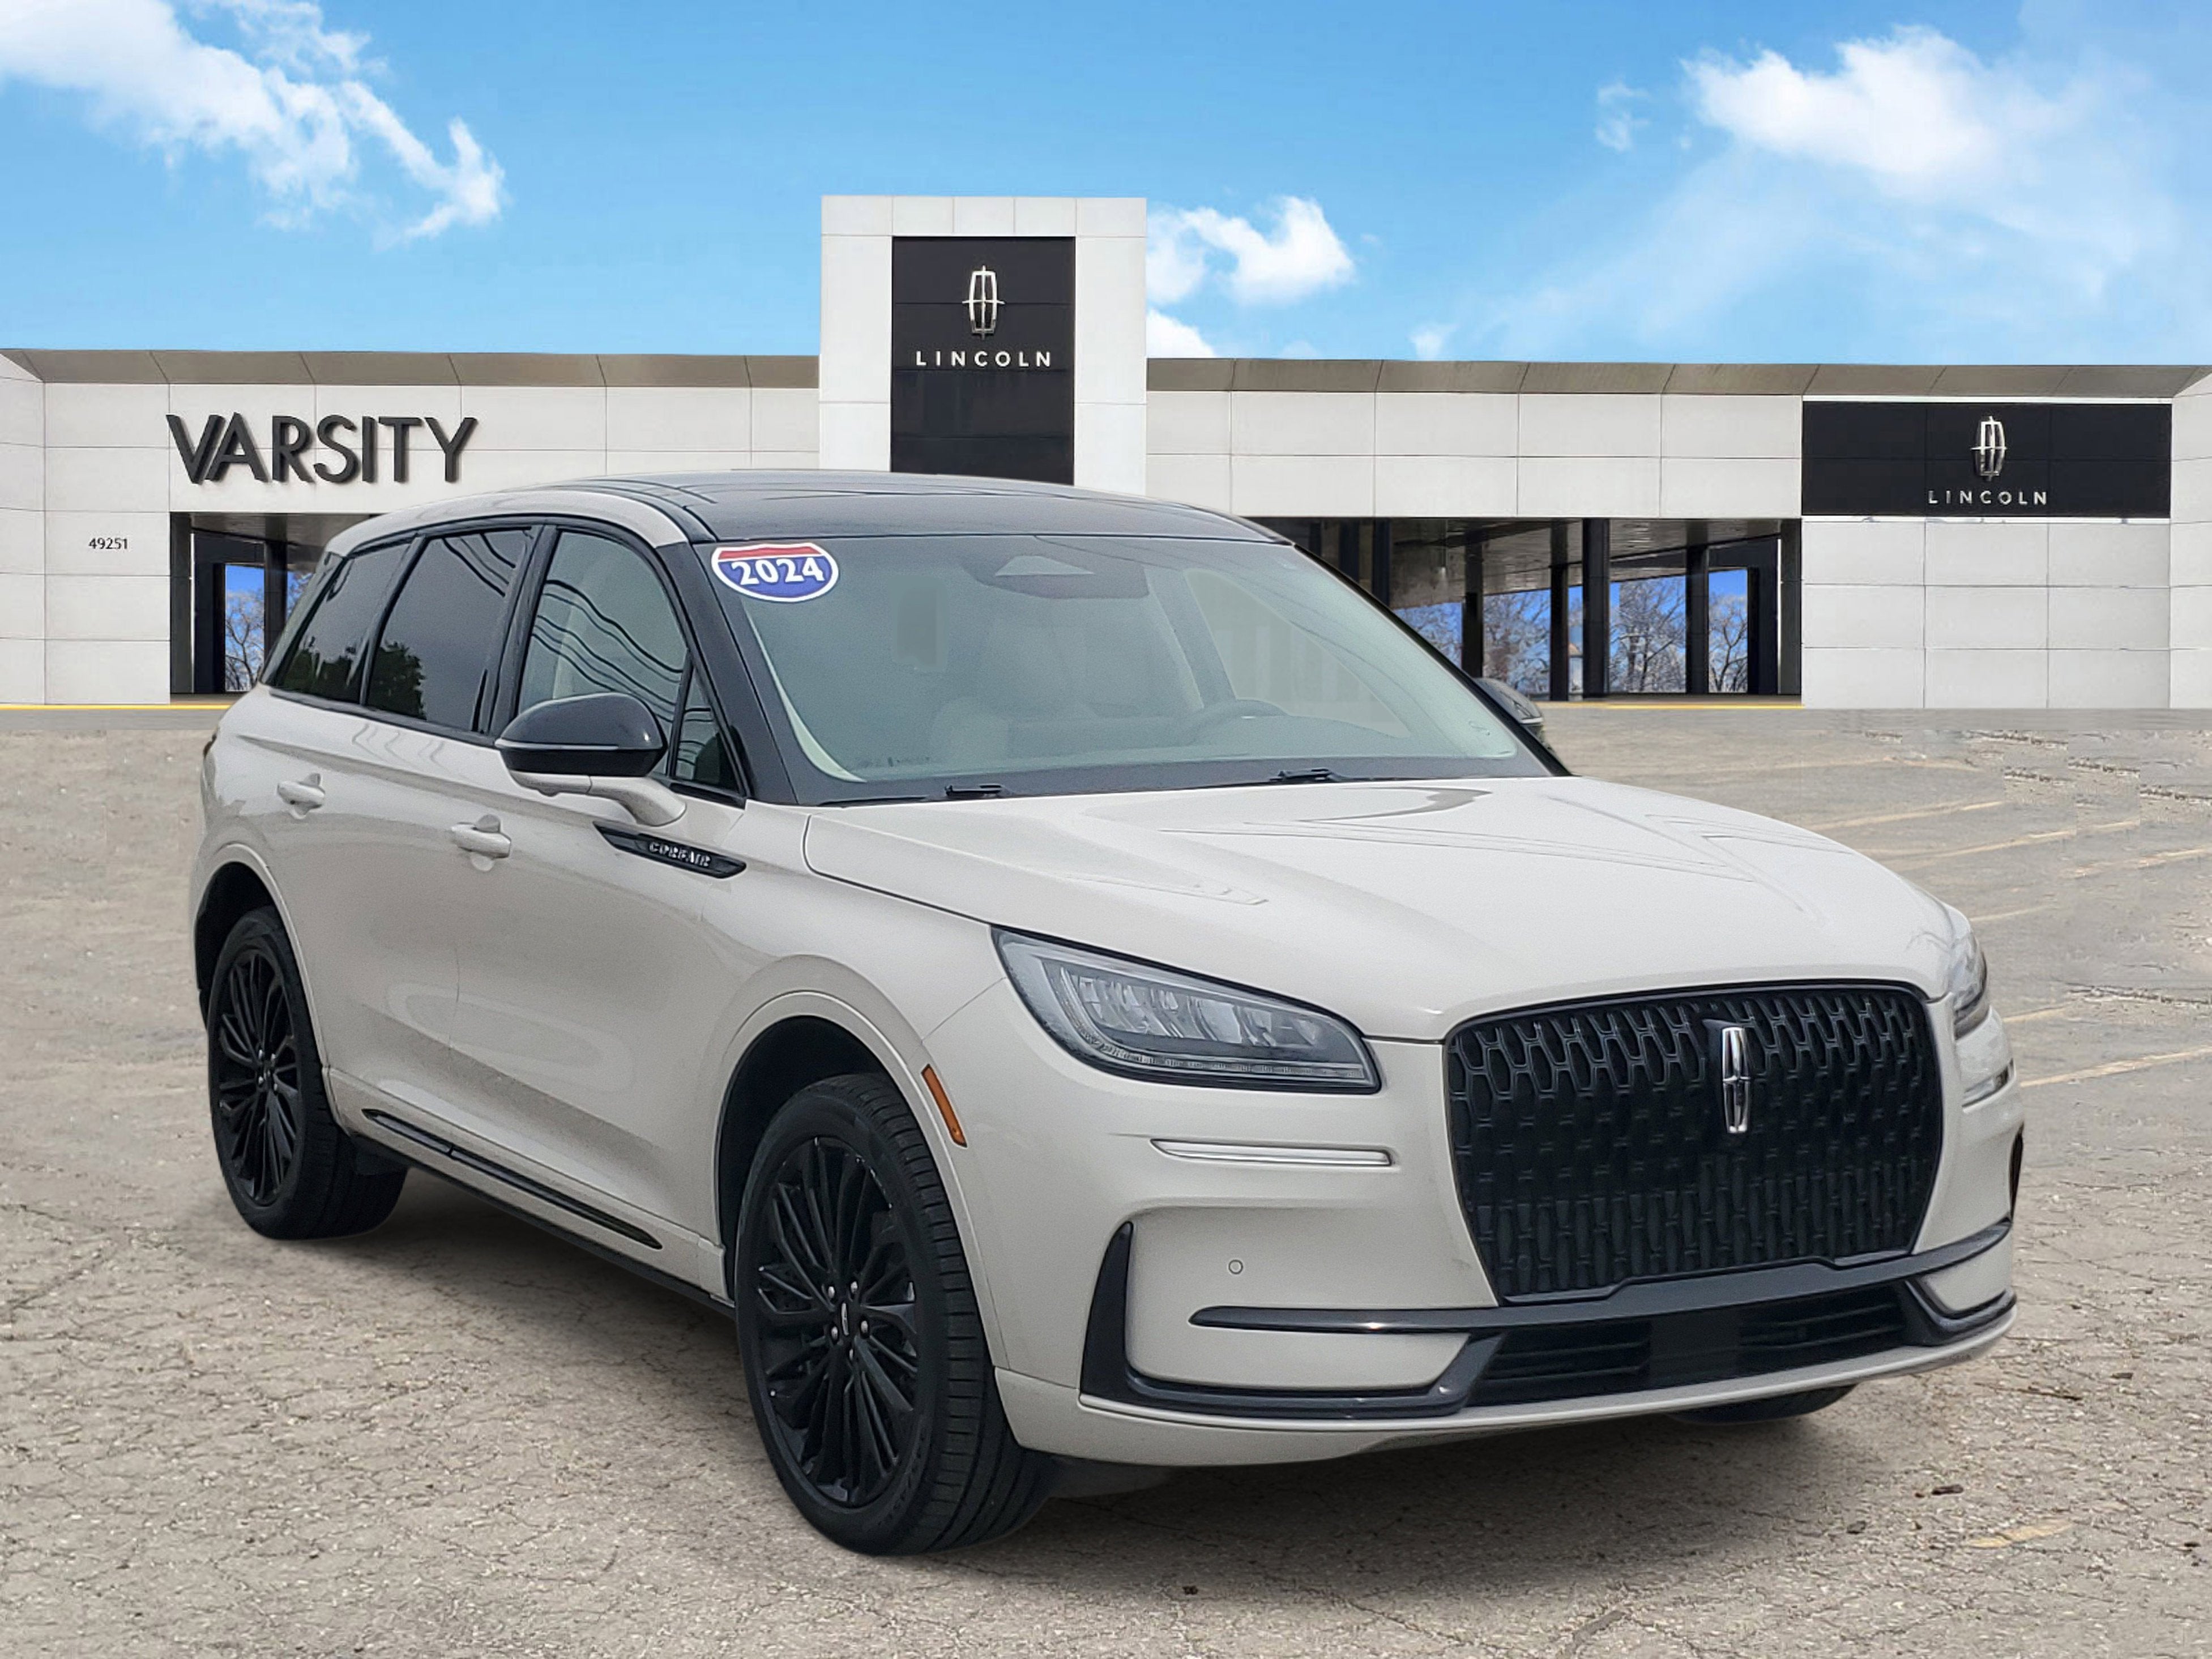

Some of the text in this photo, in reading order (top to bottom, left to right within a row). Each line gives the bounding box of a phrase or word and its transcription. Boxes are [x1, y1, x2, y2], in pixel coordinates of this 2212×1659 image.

[916, 351, 1051, 367] LINCOLN
[165, 412, 478, 485] VARSITY
[1928, 490, 2047, 505] LINCOLN
[88, 538, 129, 549] 49251
[731, 557, 825, 585] 2024
